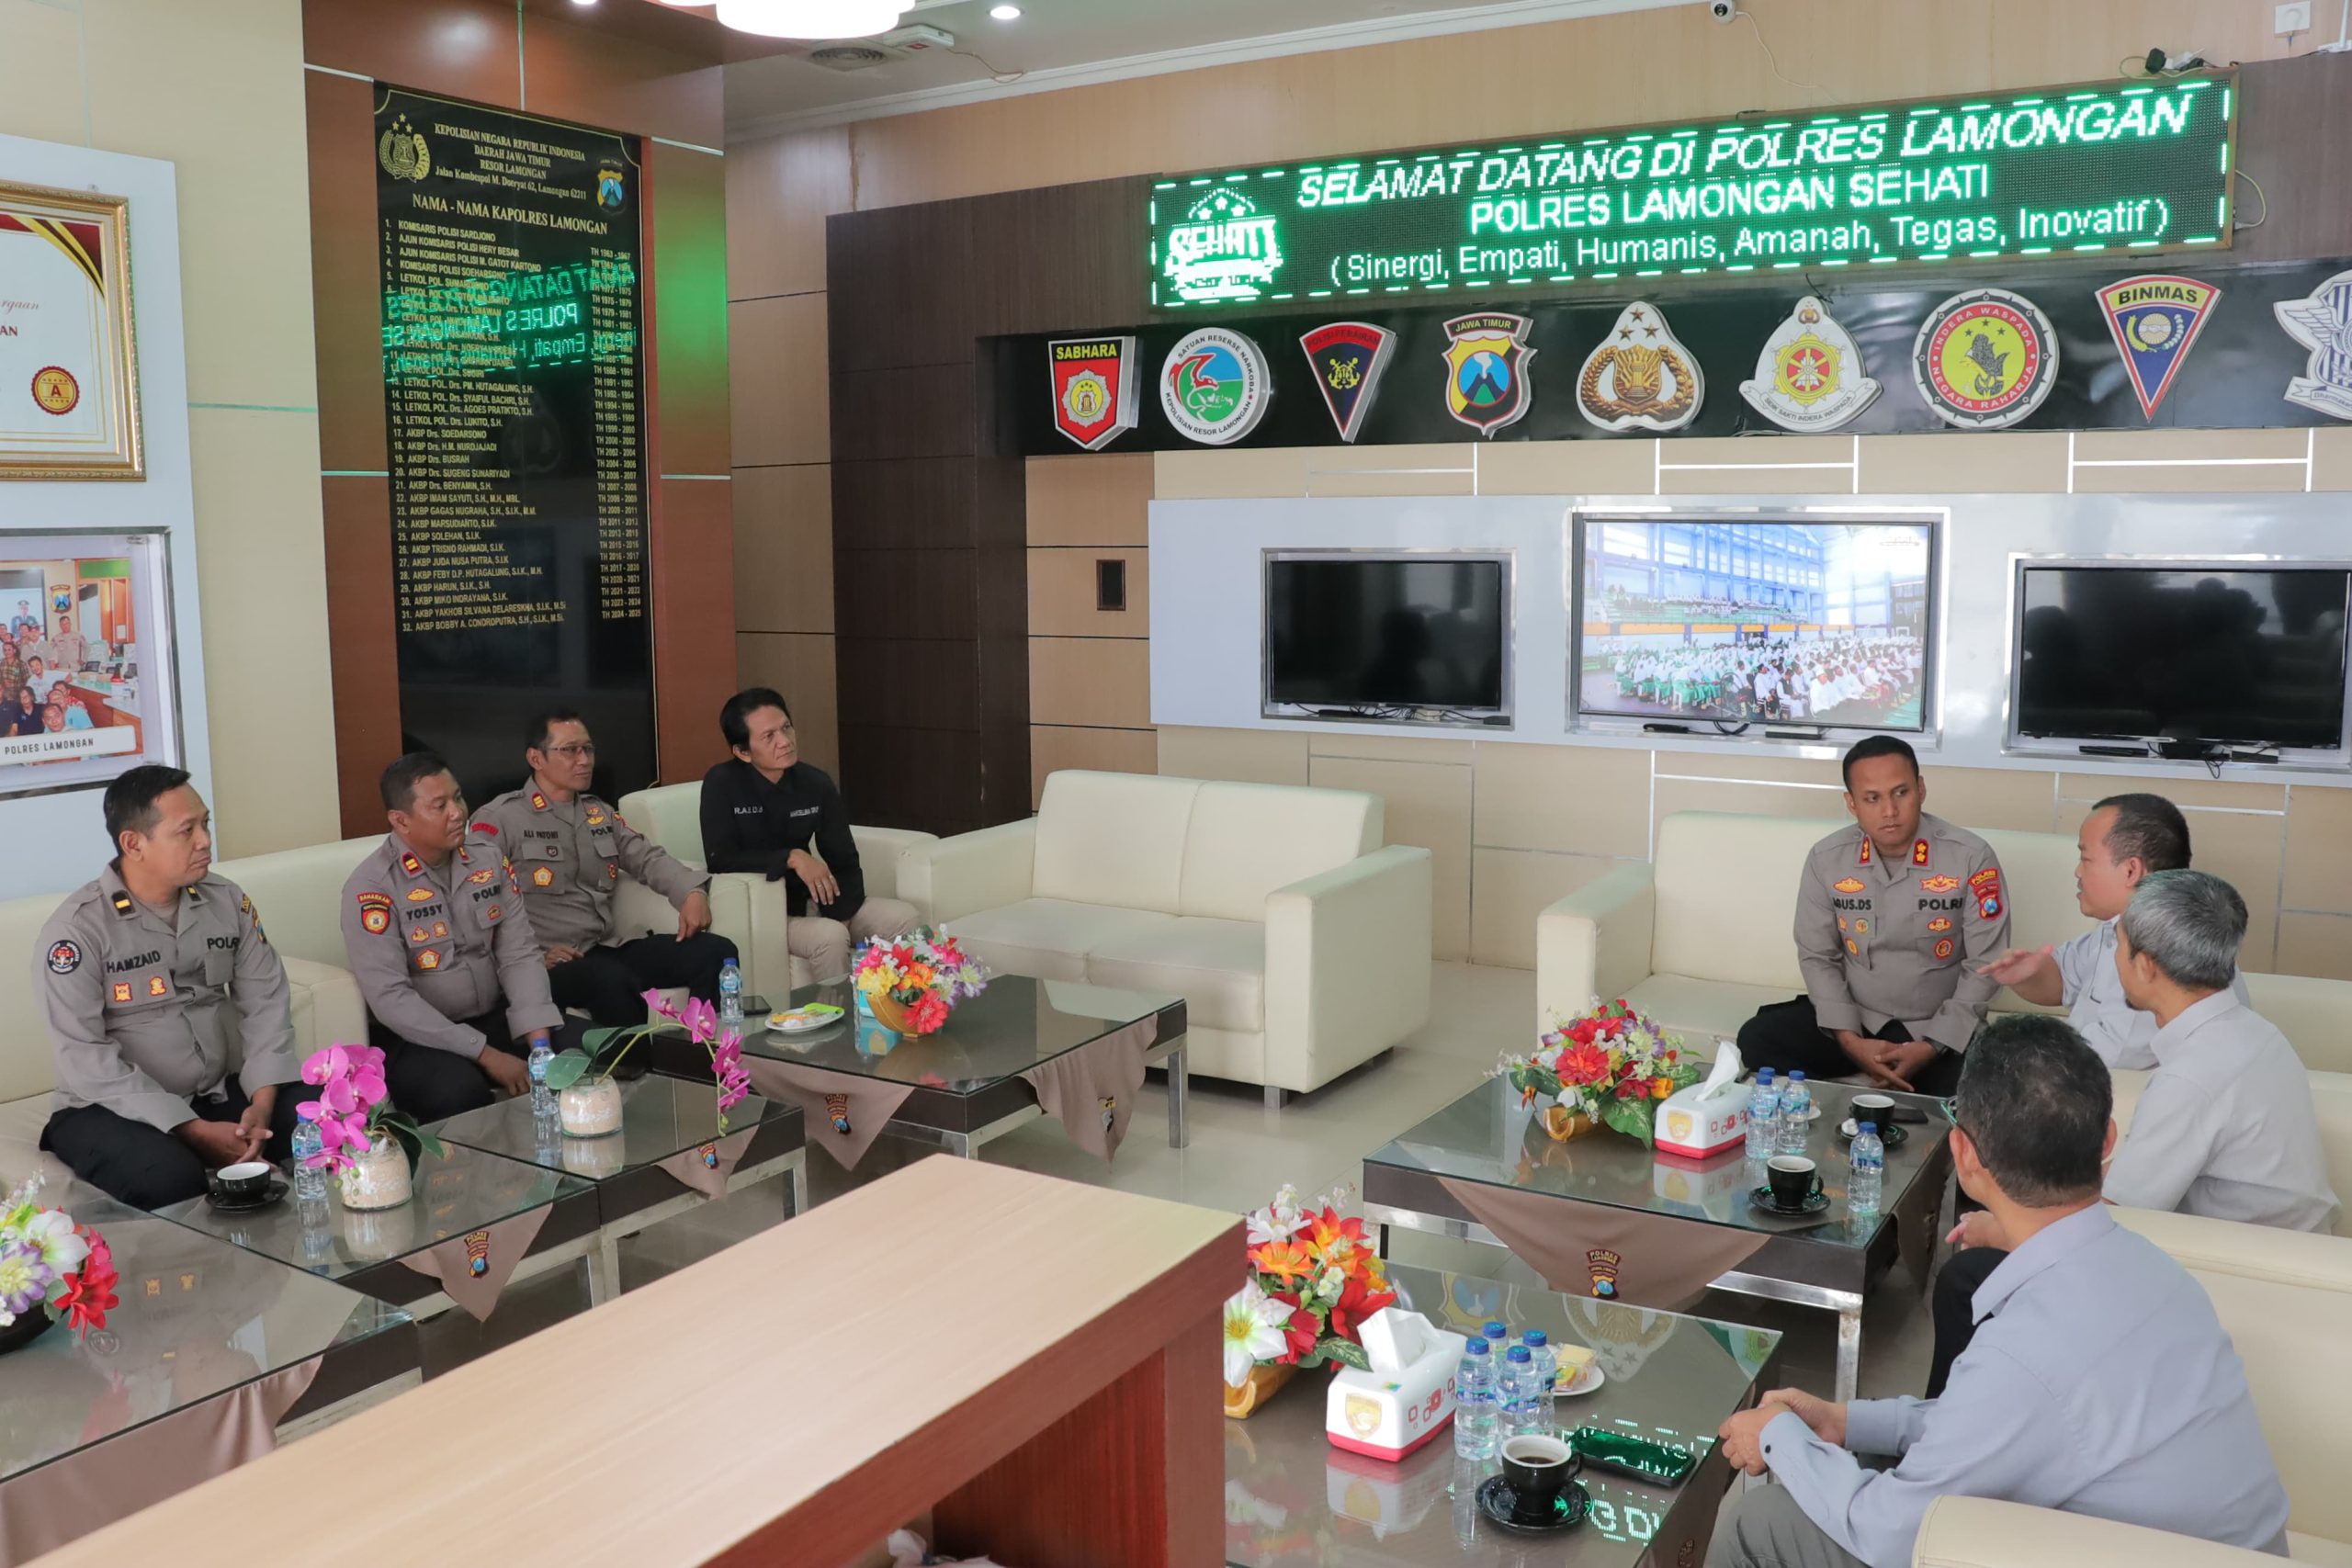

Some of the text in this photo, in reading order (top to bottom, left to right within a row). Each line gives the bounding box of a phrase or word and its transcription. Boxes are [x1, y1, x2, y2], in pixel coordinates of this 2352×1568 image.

[435, 122, 584, 162] KEPOLISIAN NEGARA REPUBLIK INDONESIA
[1298, 94, 2194, 208] SELAMAT DATANG DI POLRES LAMONGAN
[474, 144, 550, 167] DAERAH JAWA TIMUR
[480, 159, 546, 179] RESOR LAMONGAN
[1472, 164, 1988, 235] POLRES LAMONGAN SEHATI
[413, 193, 447, 211] NAMA
[457, 199, 489, 218] NAMA
[492, 205, 548, 226] KAPOLRES
[550, 214, 606, 235] LAMONGAN
[1459, 240, 1567, 276] Empati,
[1577, 231, 1724, 266] Humanis,
[1735, 220, 1880, 256] Amanah,
[1891, 214, 2007, 251] Tegas,
[2119, 285, 2198, 306] BINMAS
[1455, 319, 1511, 333] JAWA TIMUR
[1934, 308, 2032, 350] INDERA WASPADA
[1056, 344, 1117, 360] SABHARA
[1178, 335, 1254, 393] SATUAN RESERSE NARKOBA
[51, 385, 62, 398] A
[1933, 367, 2033, 408] NEGARA RAHARJA
[1166, 392, 1251, 435] KEPOLISIAN RESOR LAMONGAN
[5, 738, 94, 755] POLRES LAMONGAN
[405, 903, 444, 920] YOSSY
[1918, 897, 1963, 911] POLRI
[207, 936, 241, 952] POLR
[107, 950, 161, 974] HAMZAID
